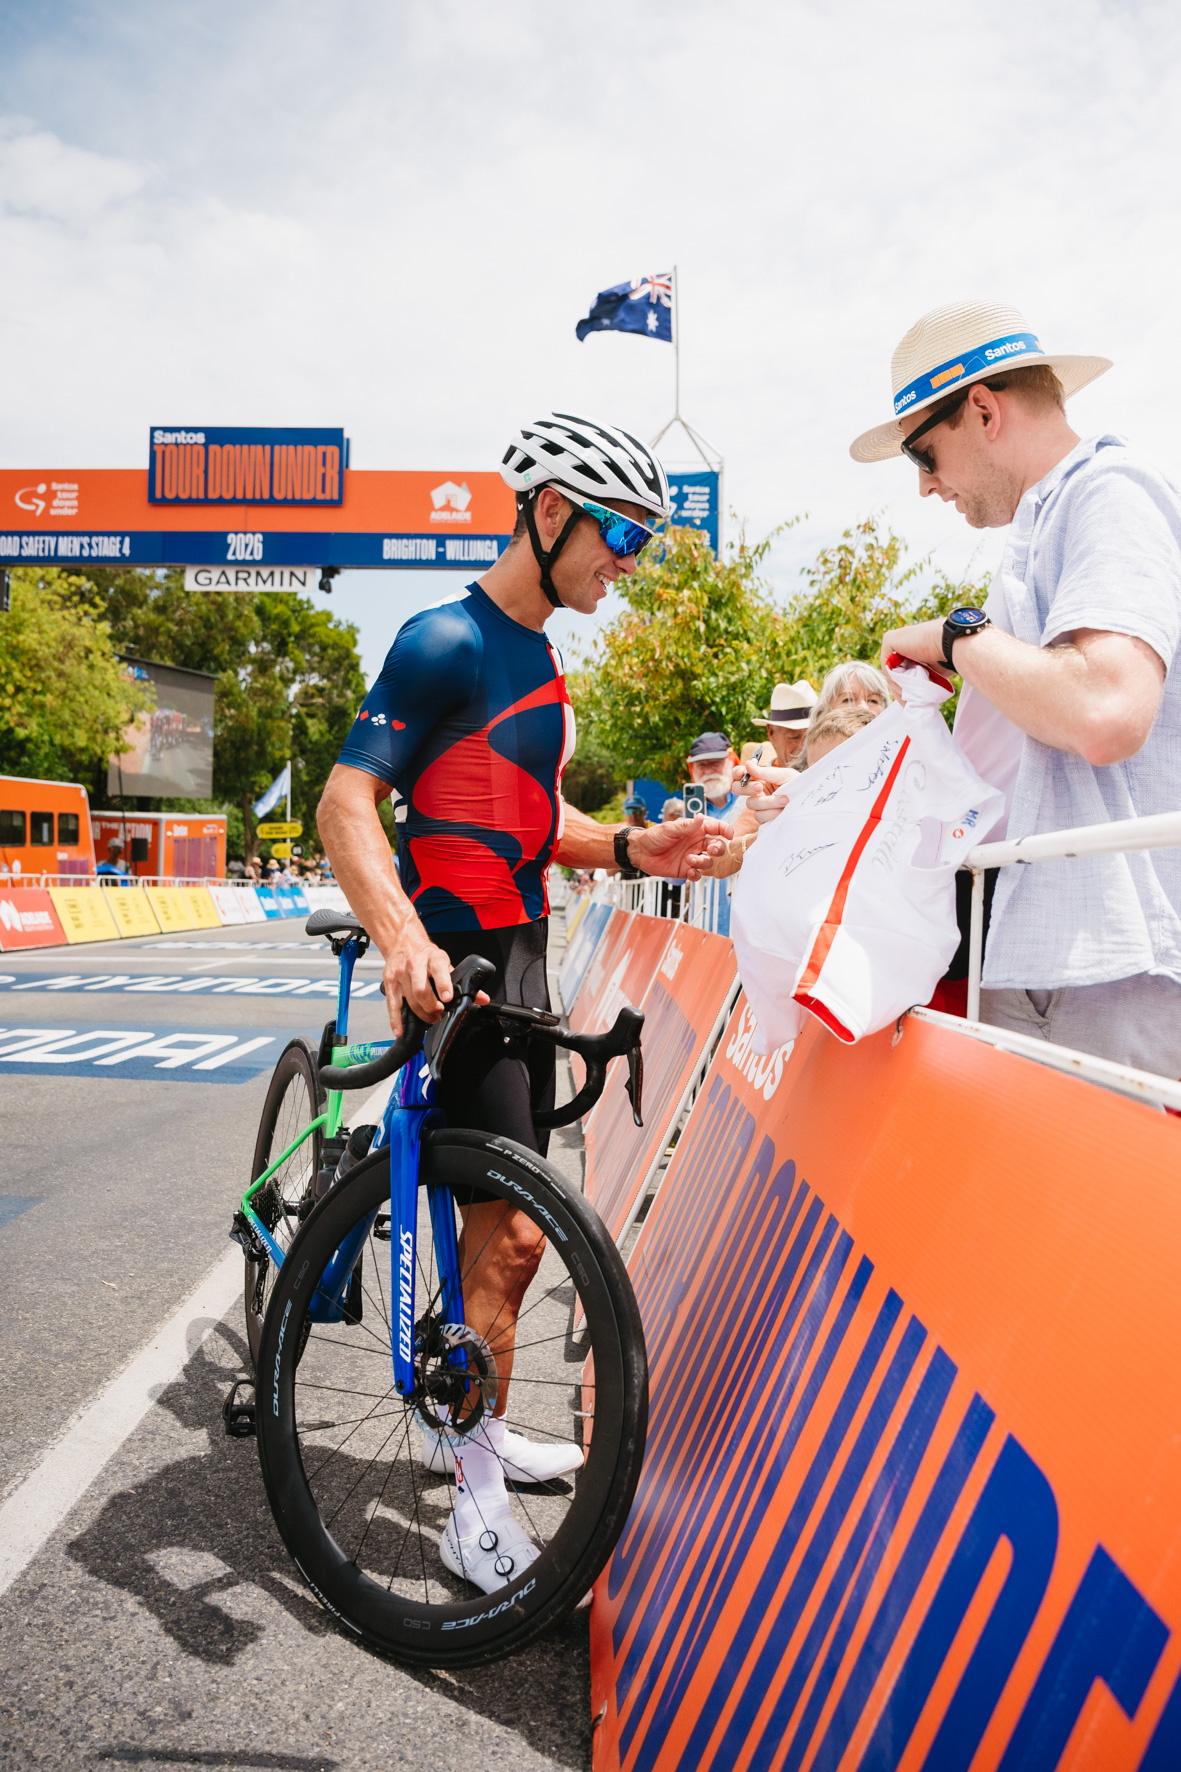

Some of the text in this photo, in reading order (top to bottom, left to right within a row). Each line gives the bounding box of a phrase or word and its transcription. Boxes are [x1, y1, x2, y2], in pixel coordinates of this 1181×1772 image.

[984, 340, 1027, 361] Santos
[895, 390, 917, 413] Santos
[153, 430, 206, 444] Santos
[153, 445, 340, 500] TOUR DOWN UNDER
[52, 499, 78, 507] down
[57, 491, 78, 499] tour
[50, 507, 78, 516] under
[21, 536, 57, 557] SAFETY
[57, 536, 91, 557] MEN'S
[91, 536, 122, 557] STAGE
[122, 536, 131, 557] 4
[226, 533, 263, 560] 2026
[383, 538, 437, 560] BRIGHTON
[445, 539, 499, 561] WILLUNGA
[194, 569, 307, 587] GARMIN
[11, 976, 385, 997] HYUNDAI
[0, 1028, 276, 1070] NDAI
[511, 1153, 541, 1175] ZERO
[486, 1169, 569, 1242] DURA-ACE
[248, 1215, 272, 1254] SPECIALIZED
[632, 1072, 757, 1372] TOUR
[400, 1224, 413, 1363] SPECIALIZED
[272, 1298, 293, 1417] DURA-ACE
[607, 1133, 875, 1769] DOWN
[310, 1582, 342, 1618] PIRELLI
[440, 1577, 537, 1631] DURA-ACE
